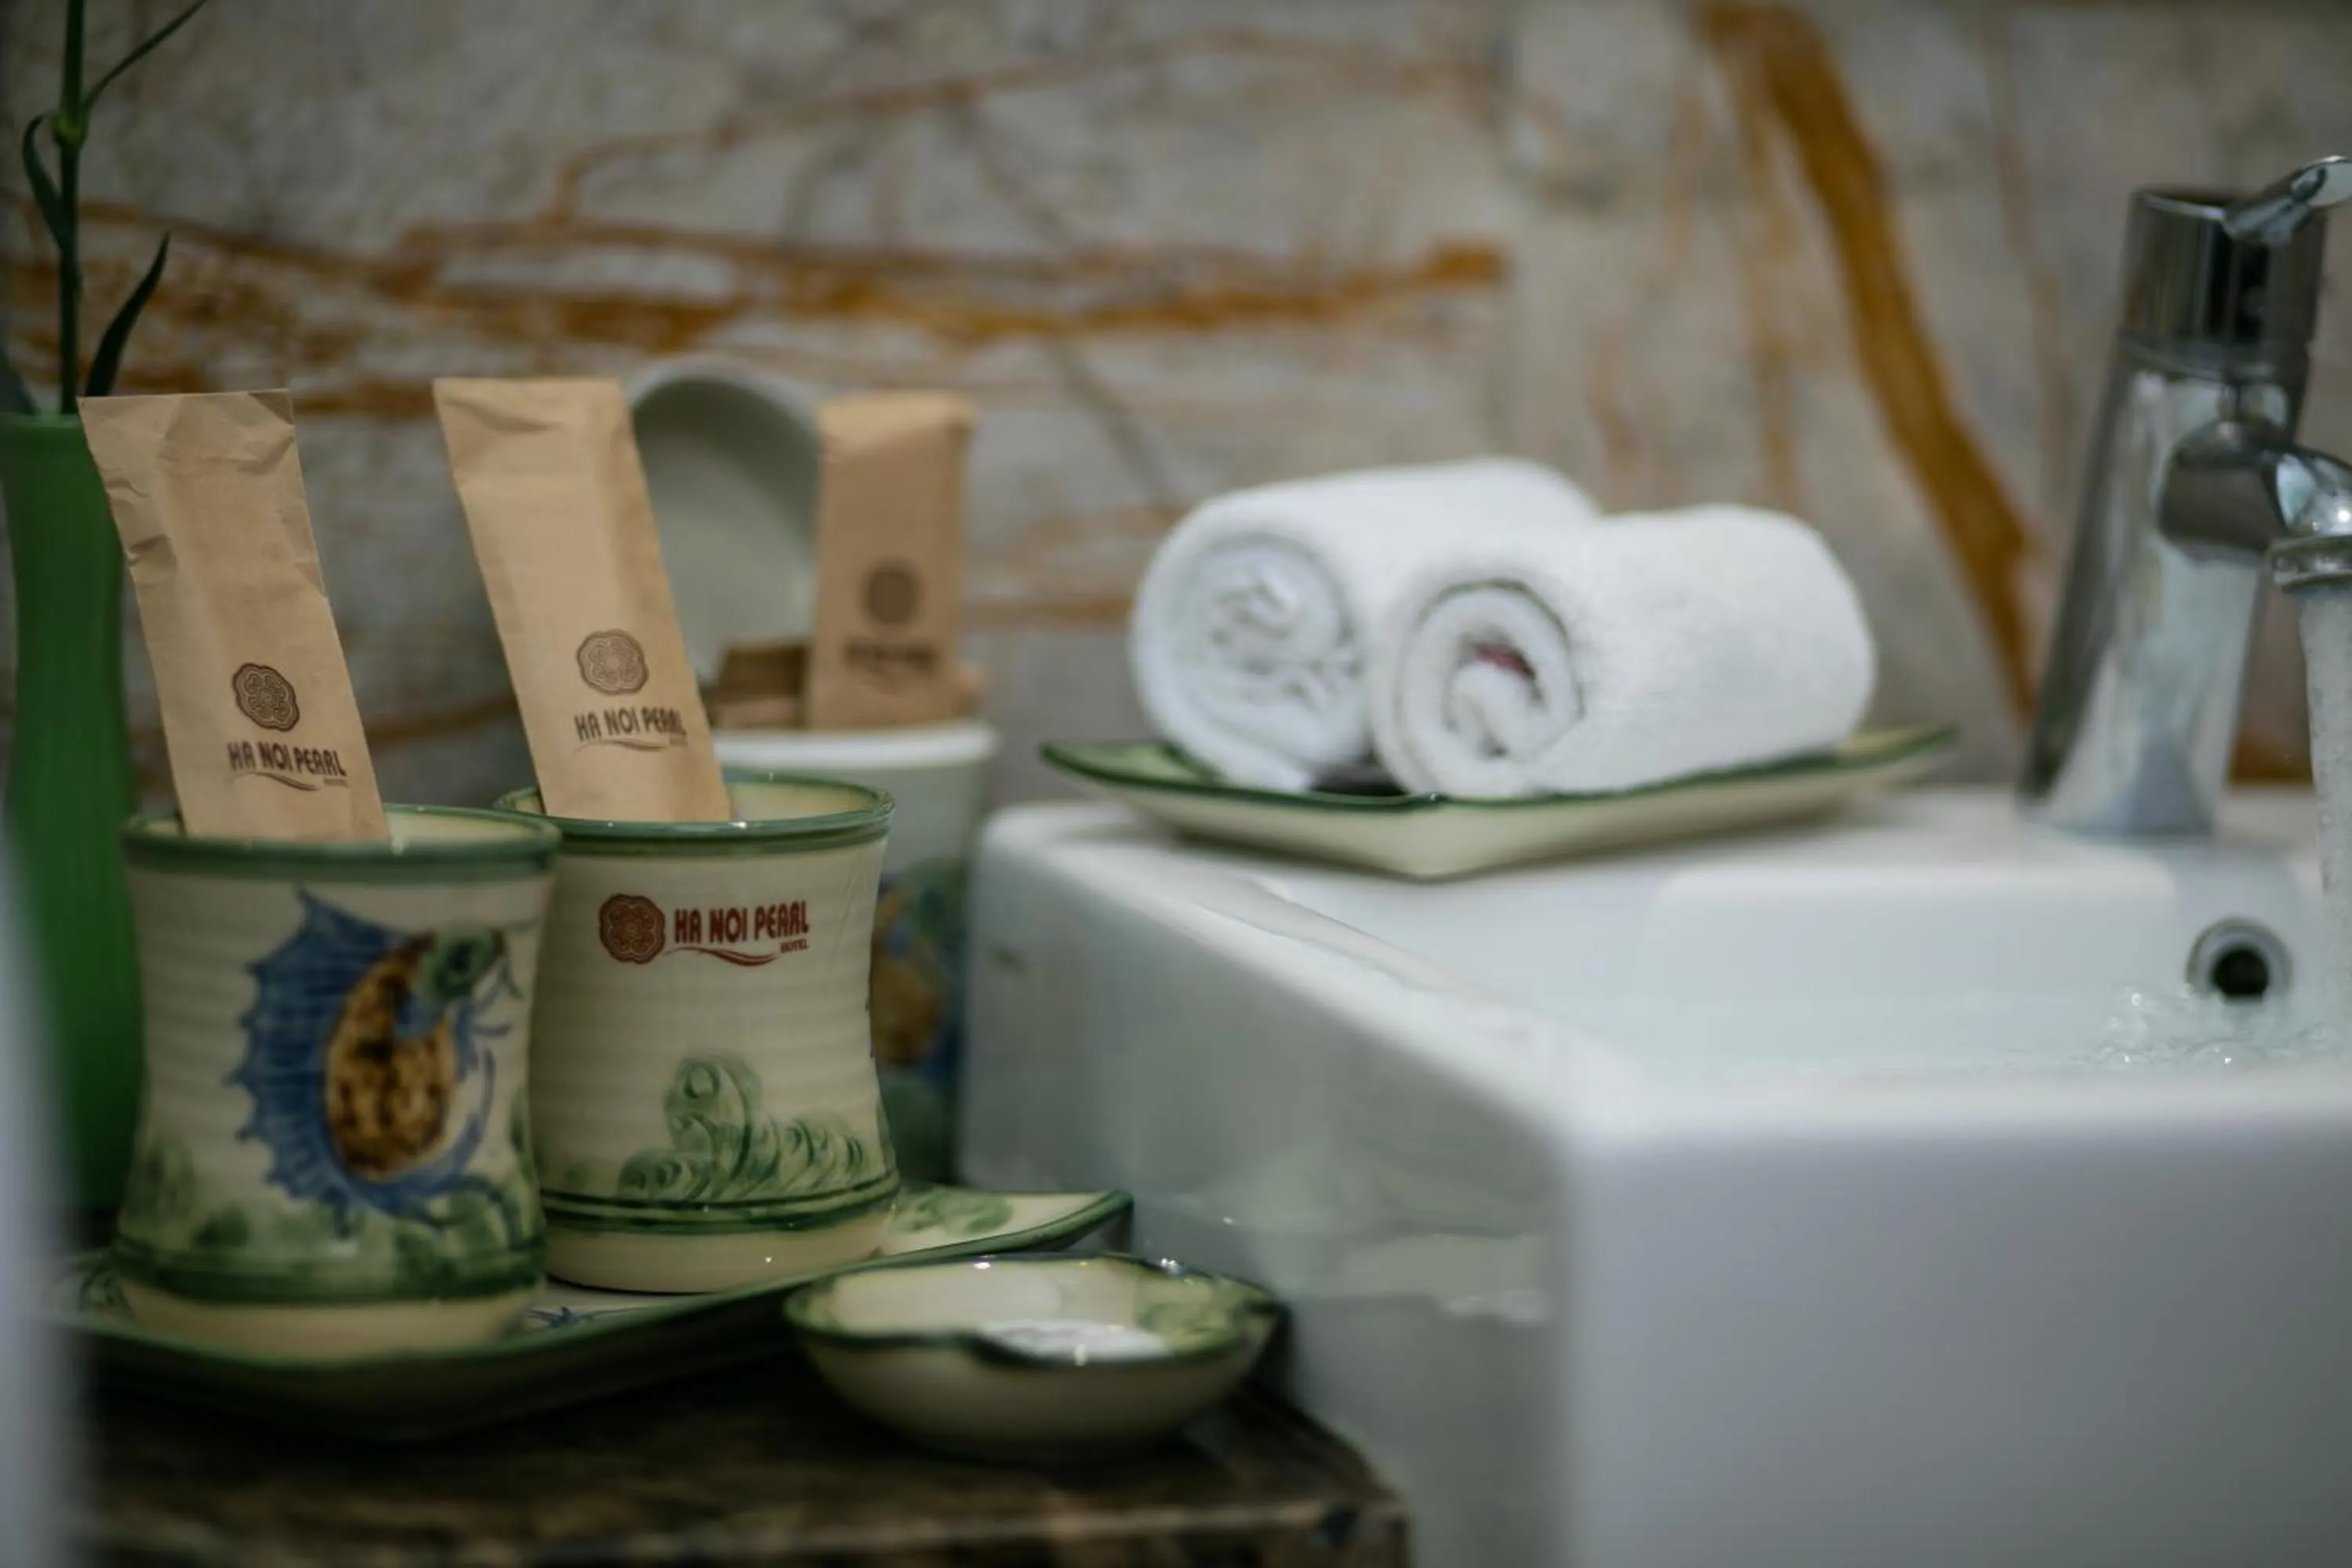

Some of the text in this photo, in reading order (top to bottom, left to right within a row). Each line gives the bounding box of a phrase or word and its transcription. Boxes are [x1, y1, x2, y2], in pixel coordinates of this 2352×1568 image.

[574, 712, 602, 741] HA
[604, 706, 641, 736] NOI
[227, 741, 347, 777] HA NOI PEARL
[674, 899, 809, 944] HA NOI PEARL
